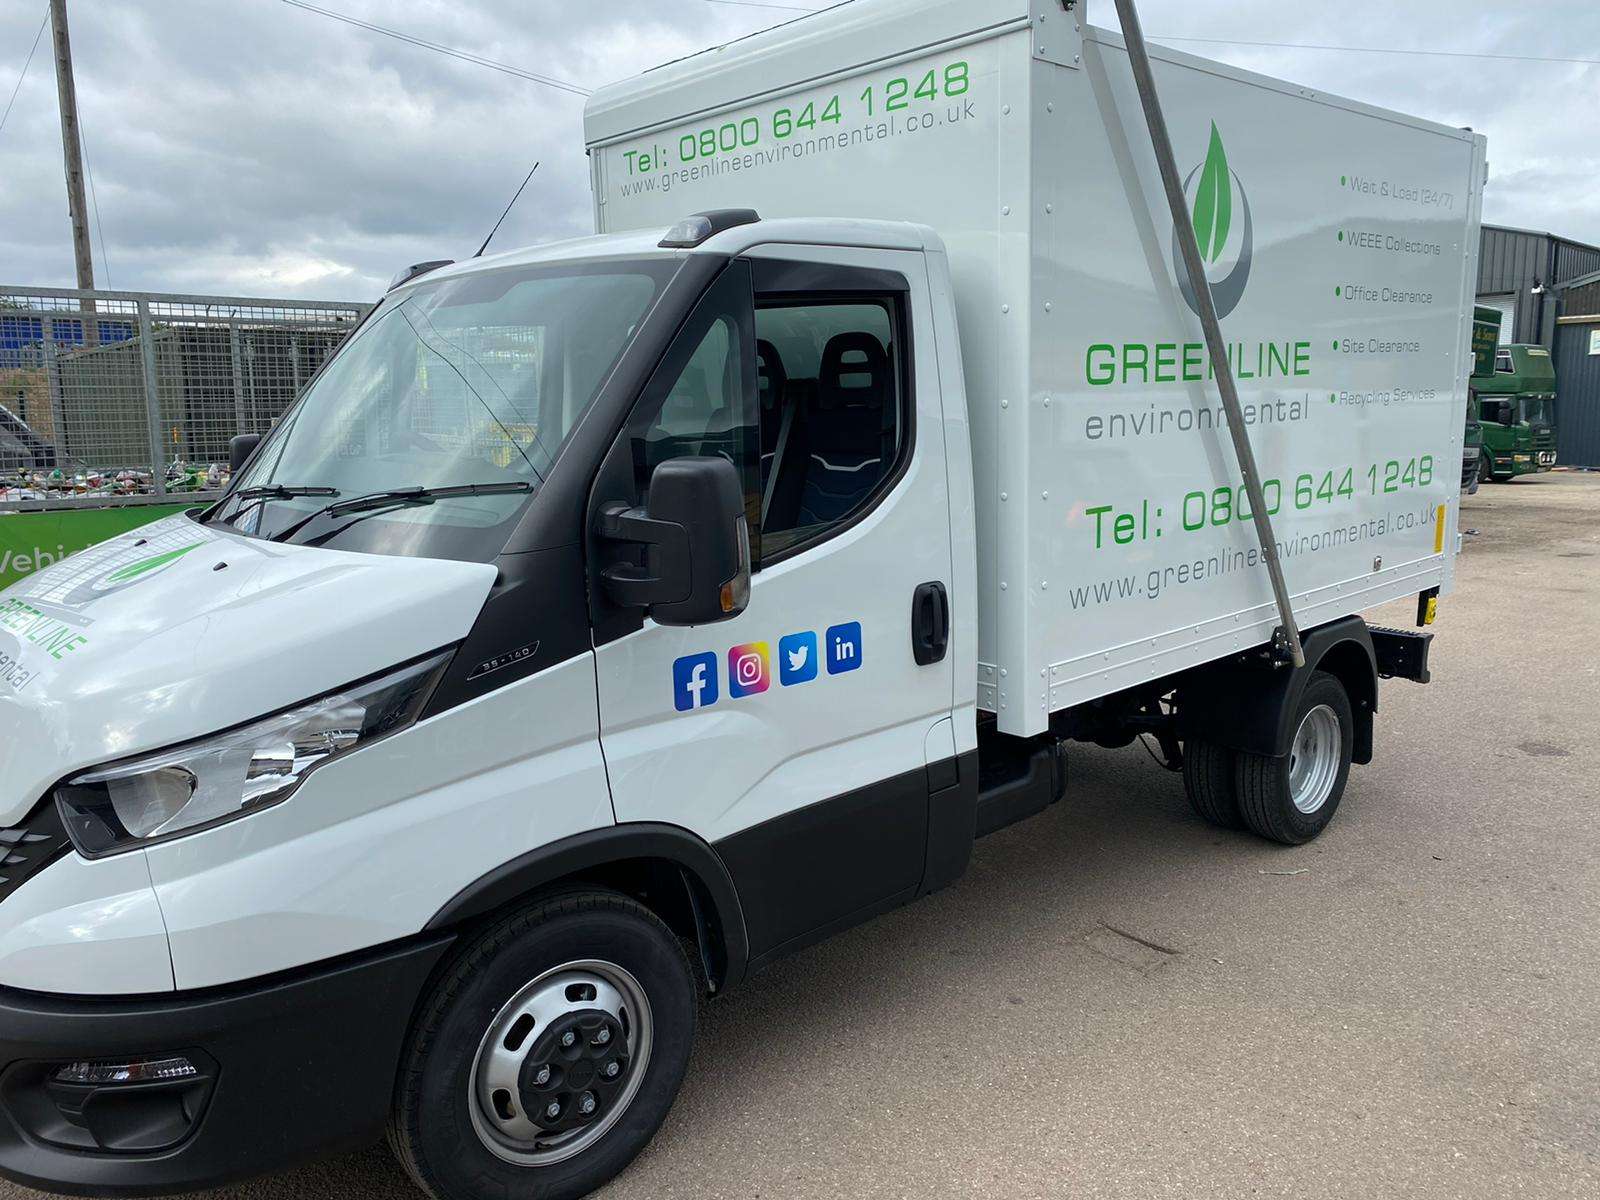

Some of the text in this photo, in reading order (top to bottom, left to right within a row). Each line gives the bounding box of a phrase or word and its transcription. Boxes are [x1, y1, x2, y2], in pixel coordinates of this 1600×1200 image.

[623, 61, 970, 176] Tel: 0800 644 1248
[619, 98, 977, 199] www.greenlineenvironmental.co.uk
[1350, 176, 1377, 195] Wait
[1380, 182, 1390, 197] &
[1392, 183, 1419, 202] Load
[1347, 230, 1441, 256] WEEE Collections
[1344, 285, 1433, 304] Office Clearance
[1342, 338, 1421, 354] Site Clearance
[1339, 386, 1437, 408] Recycling Services
[1085, 455, 1434, 549] Tel: 0800 644 1248
[482, 648, 530, 671] 35-140
